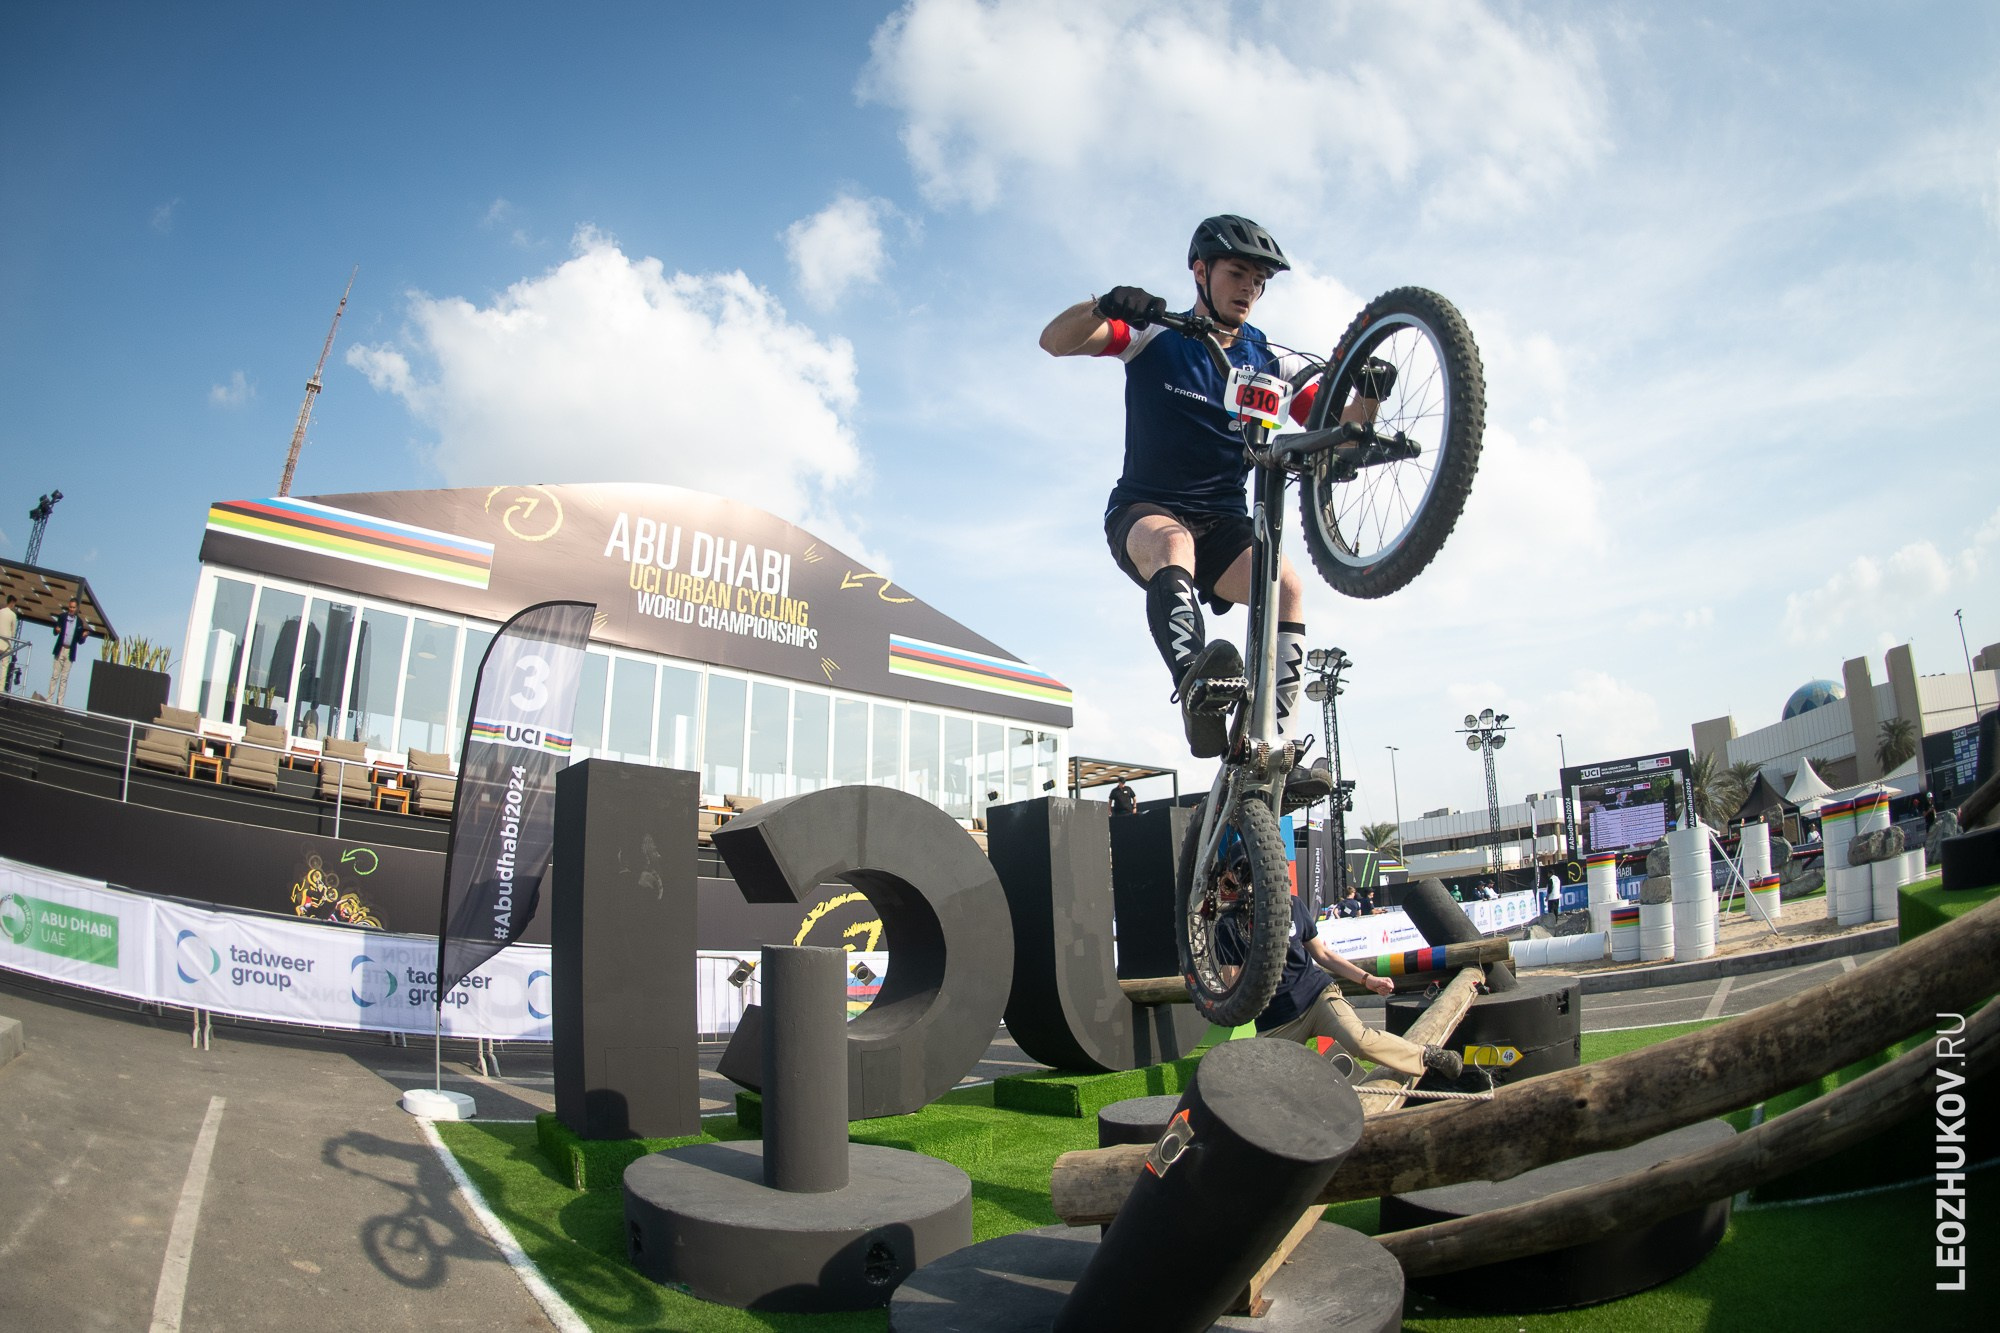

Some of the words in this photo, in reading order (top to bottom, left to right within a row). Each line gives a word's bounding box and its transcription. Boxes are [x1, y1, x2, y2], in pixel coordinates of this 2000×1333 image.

[1243, 387, 1276, 412] 310
[604, 512, 682, 571] ABU
[690, 531, 791, 598] DHABI
[629, 563, 662, 595] UCI
[666, 571, 732, 610] URBAN
[736, 587, 809, 627] CYCLING
[637, 591, 694, 624] WORLD
[699, 604, 818, 650] CHAMPIONSHIPS
[509, 654, 551, 712] 3
[505, 725, 541, 747] UCI
[1584, 769, 1599, 778] UCI
[494, 765, 527, 940] #Abudhabi2024
[40, 911, 68, 929] ABU
[70, 917, 112, 938] DHABI
[41, 928, 66, 947] UAE
[230, 944, 315, 973] tadweer
[231, 967, 292, 992] group
[406, 966, 493, 990] tadweer
[408, 988, 470, 1009] group
[1503, 1051, 1514, 1061] 4B
